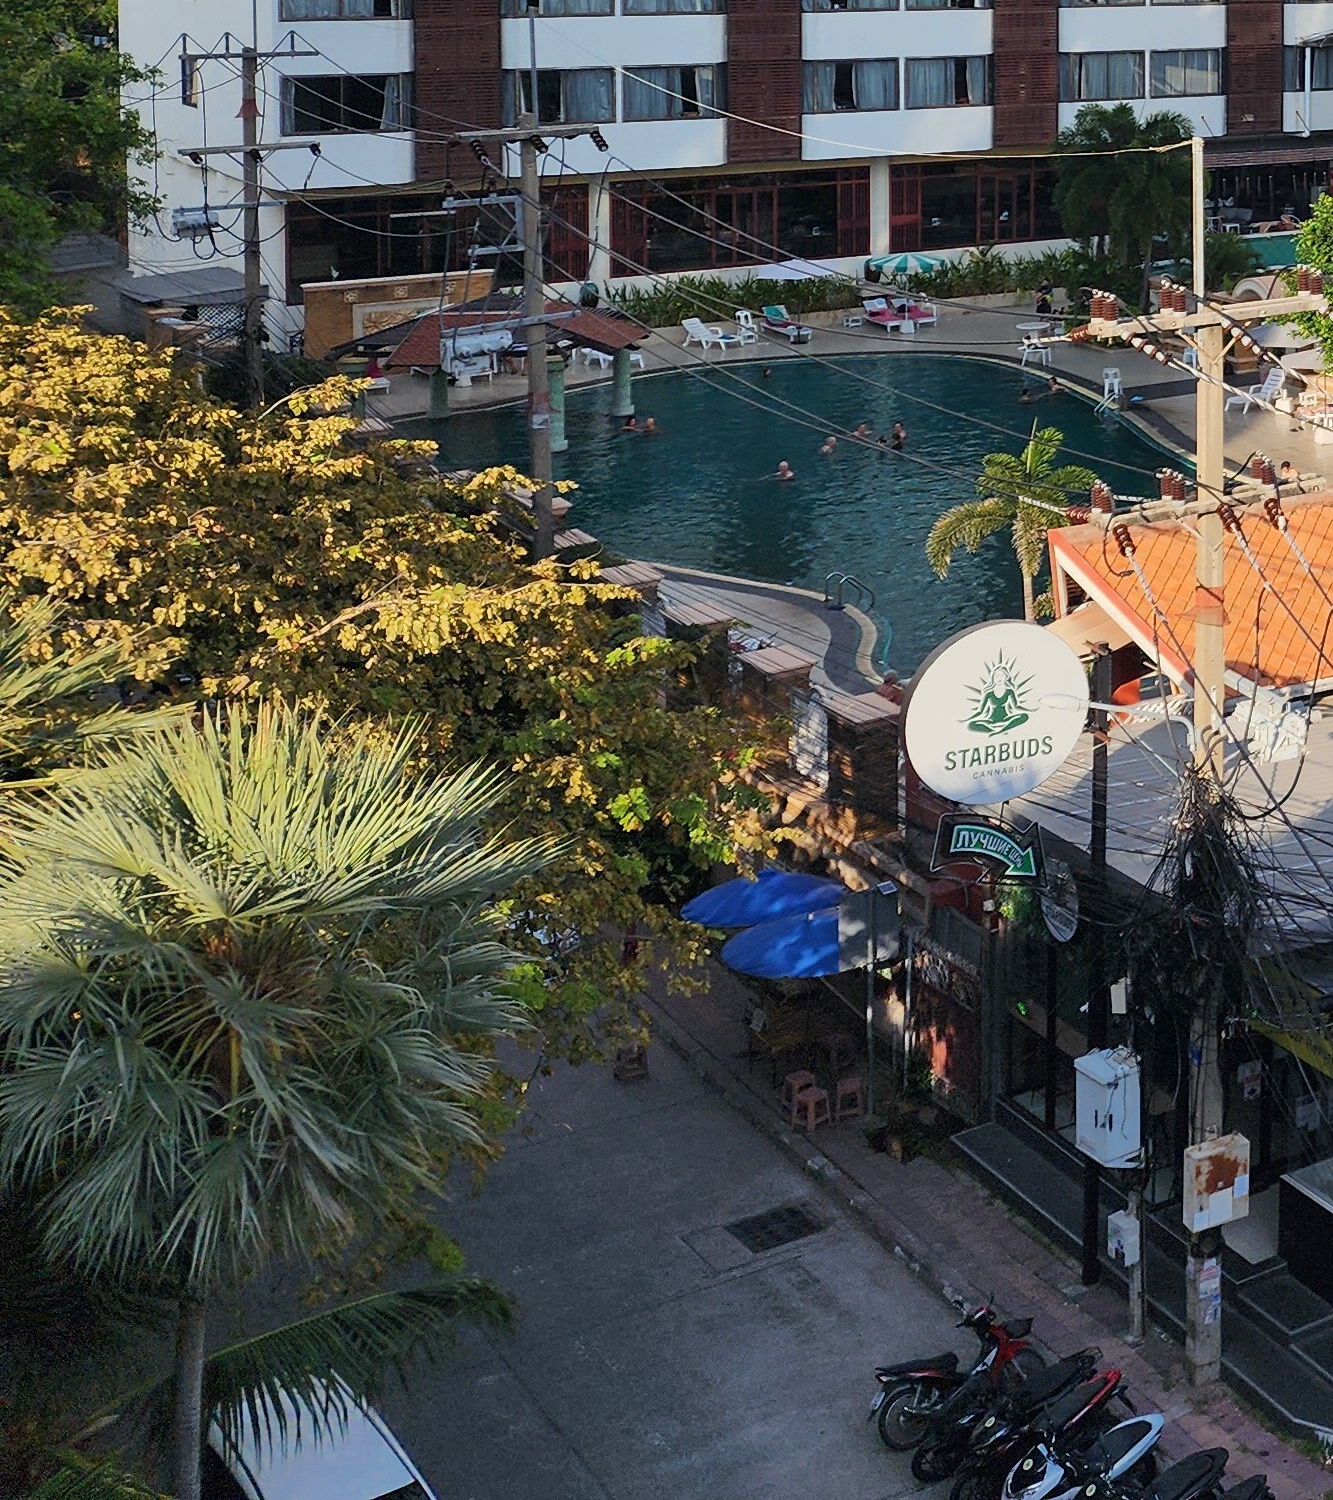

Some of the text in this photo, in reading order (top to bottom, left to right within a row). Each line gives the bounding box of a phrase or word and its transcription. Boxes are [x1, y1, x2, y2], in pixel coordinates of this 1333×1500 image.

[944, 735, 1053, 771] STARBUDS
[972, 764, 1025, 780] CANNABIS
[957, 830, 1012, 856] ЛУЧШИЕ
